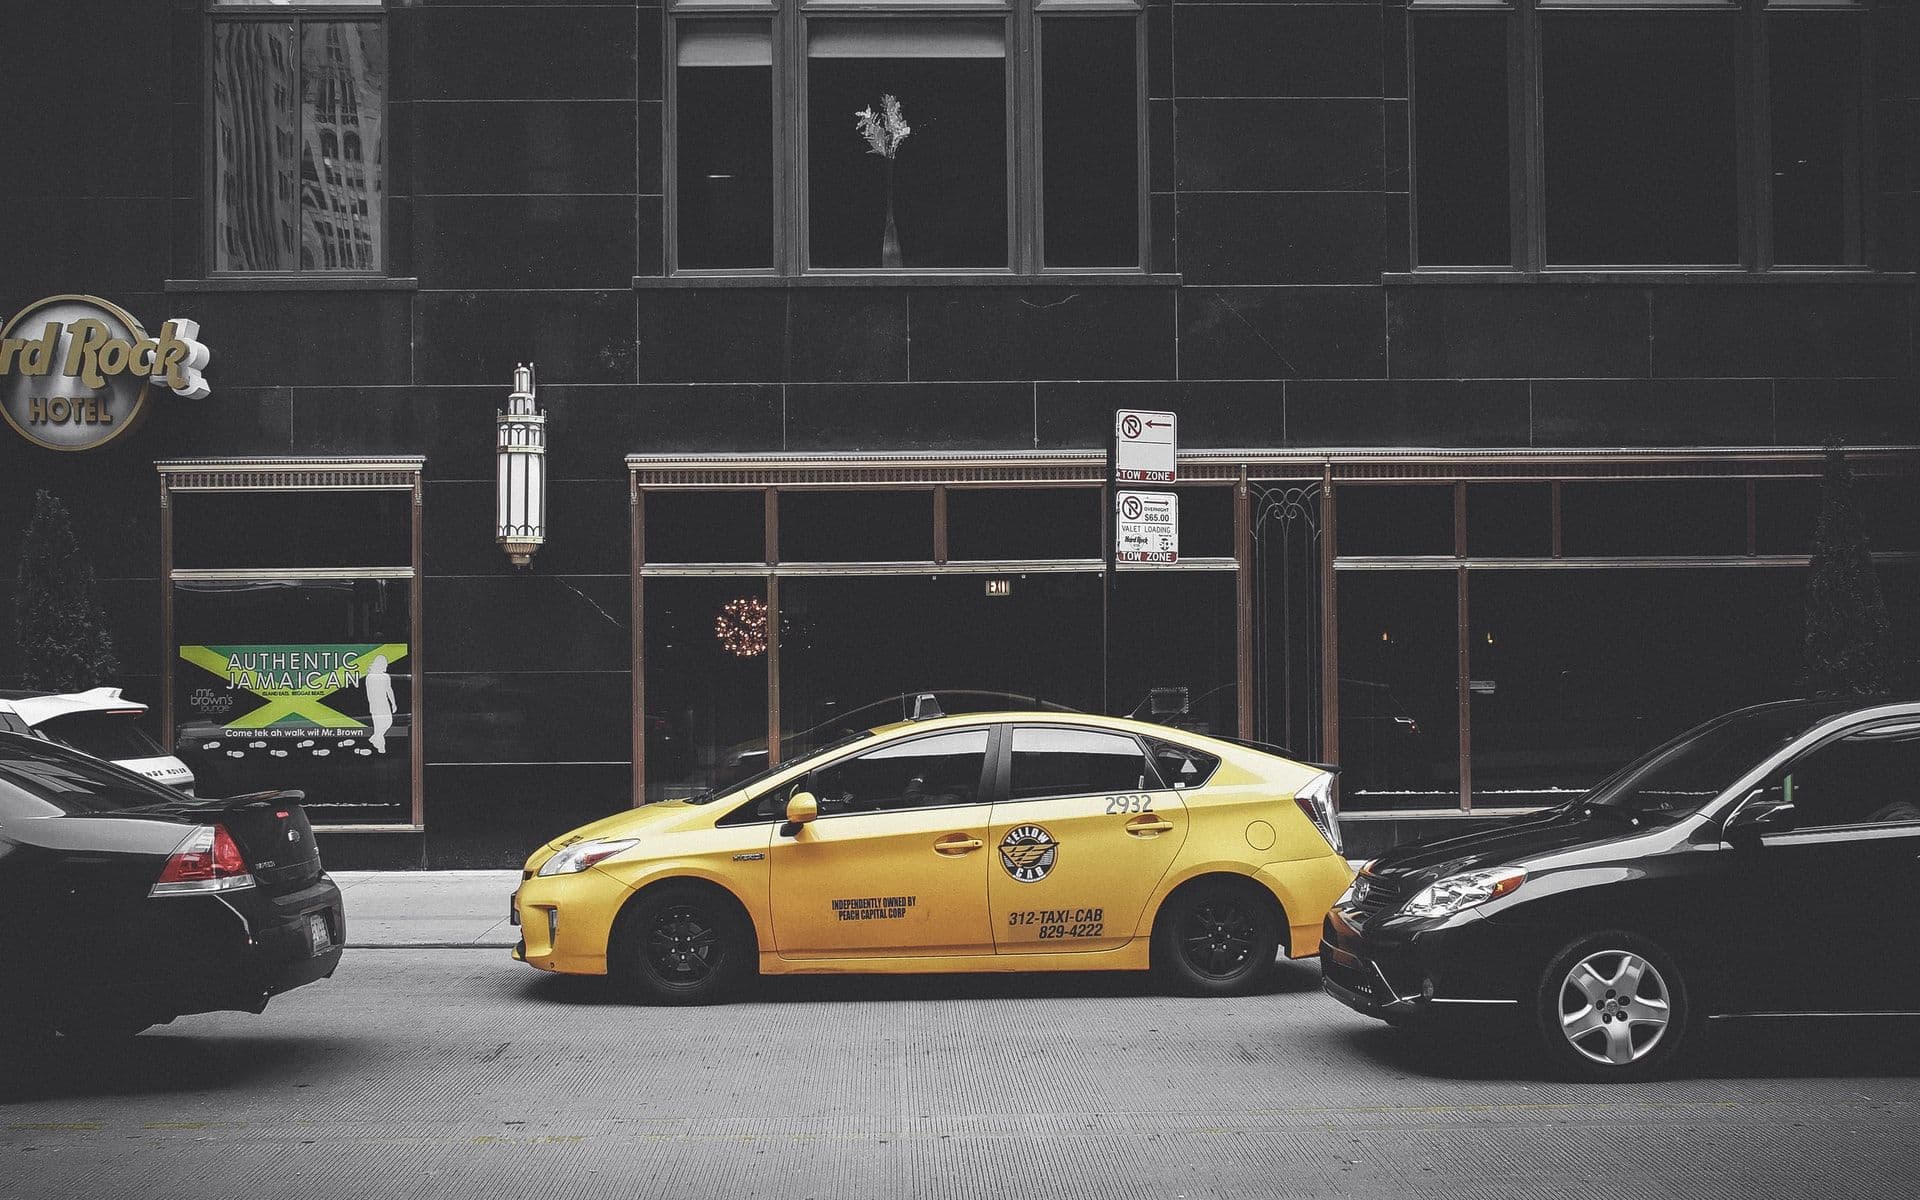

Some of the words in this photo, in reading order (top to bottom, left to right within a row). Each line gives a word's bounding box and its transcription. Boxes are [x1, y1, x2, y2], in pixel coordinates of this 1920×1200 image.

[0, 321, 63, 376] rd
[63, 318, 196, 391] Rock
[28, 397, 113, 425] HOTEL
[1121, 470, 1141, 480] TOW
[1145, 471, 1171, 481] ZONE
[1144, 513, 1170, 522] $65.00
[1121, 525, 1141, 533] VALET
[1144, 526, 1171, 534] LOADING
[1121, 551, 1141, 561] TOW
[1146, 552, 1172, 562] ZONE
[988, 578, 1008, 594] EXIT
[227, 652, 360, 670] AUTHENTIC
[225, 671, 360, 690] JAMAICAN
[190, 694, 233, 706] brown's
[225, 729, 253, 737] Come
[254, 728, 268, 737] tek
[270, 728, 282, 737] ah
[284, 728, 305, 737] walk
[307, 728, 319, 737] wit
[321, 728, 335, 737] Mr.
[336, 728, 364, 737] Brown
[1105, 794, 1154, 815] 2932
[1004, 826, 1050, 845] YELLOW
[1015, 865, 1045, 879] CAB
[831, 898, 882, 910] INDEPENDENTLY
[882, 896, 907, 908] OWNED
[907, 896, 916, 907] BY
[838, 909, 860, 921] PEACH
[860, 908, 888, 920] CAPITAL
[888, 908, 906, 919] CORP
[1008, 908, 1104, 926] 312-TAXI-CAB
[1039, 923, 1104, 939] 829-4222
